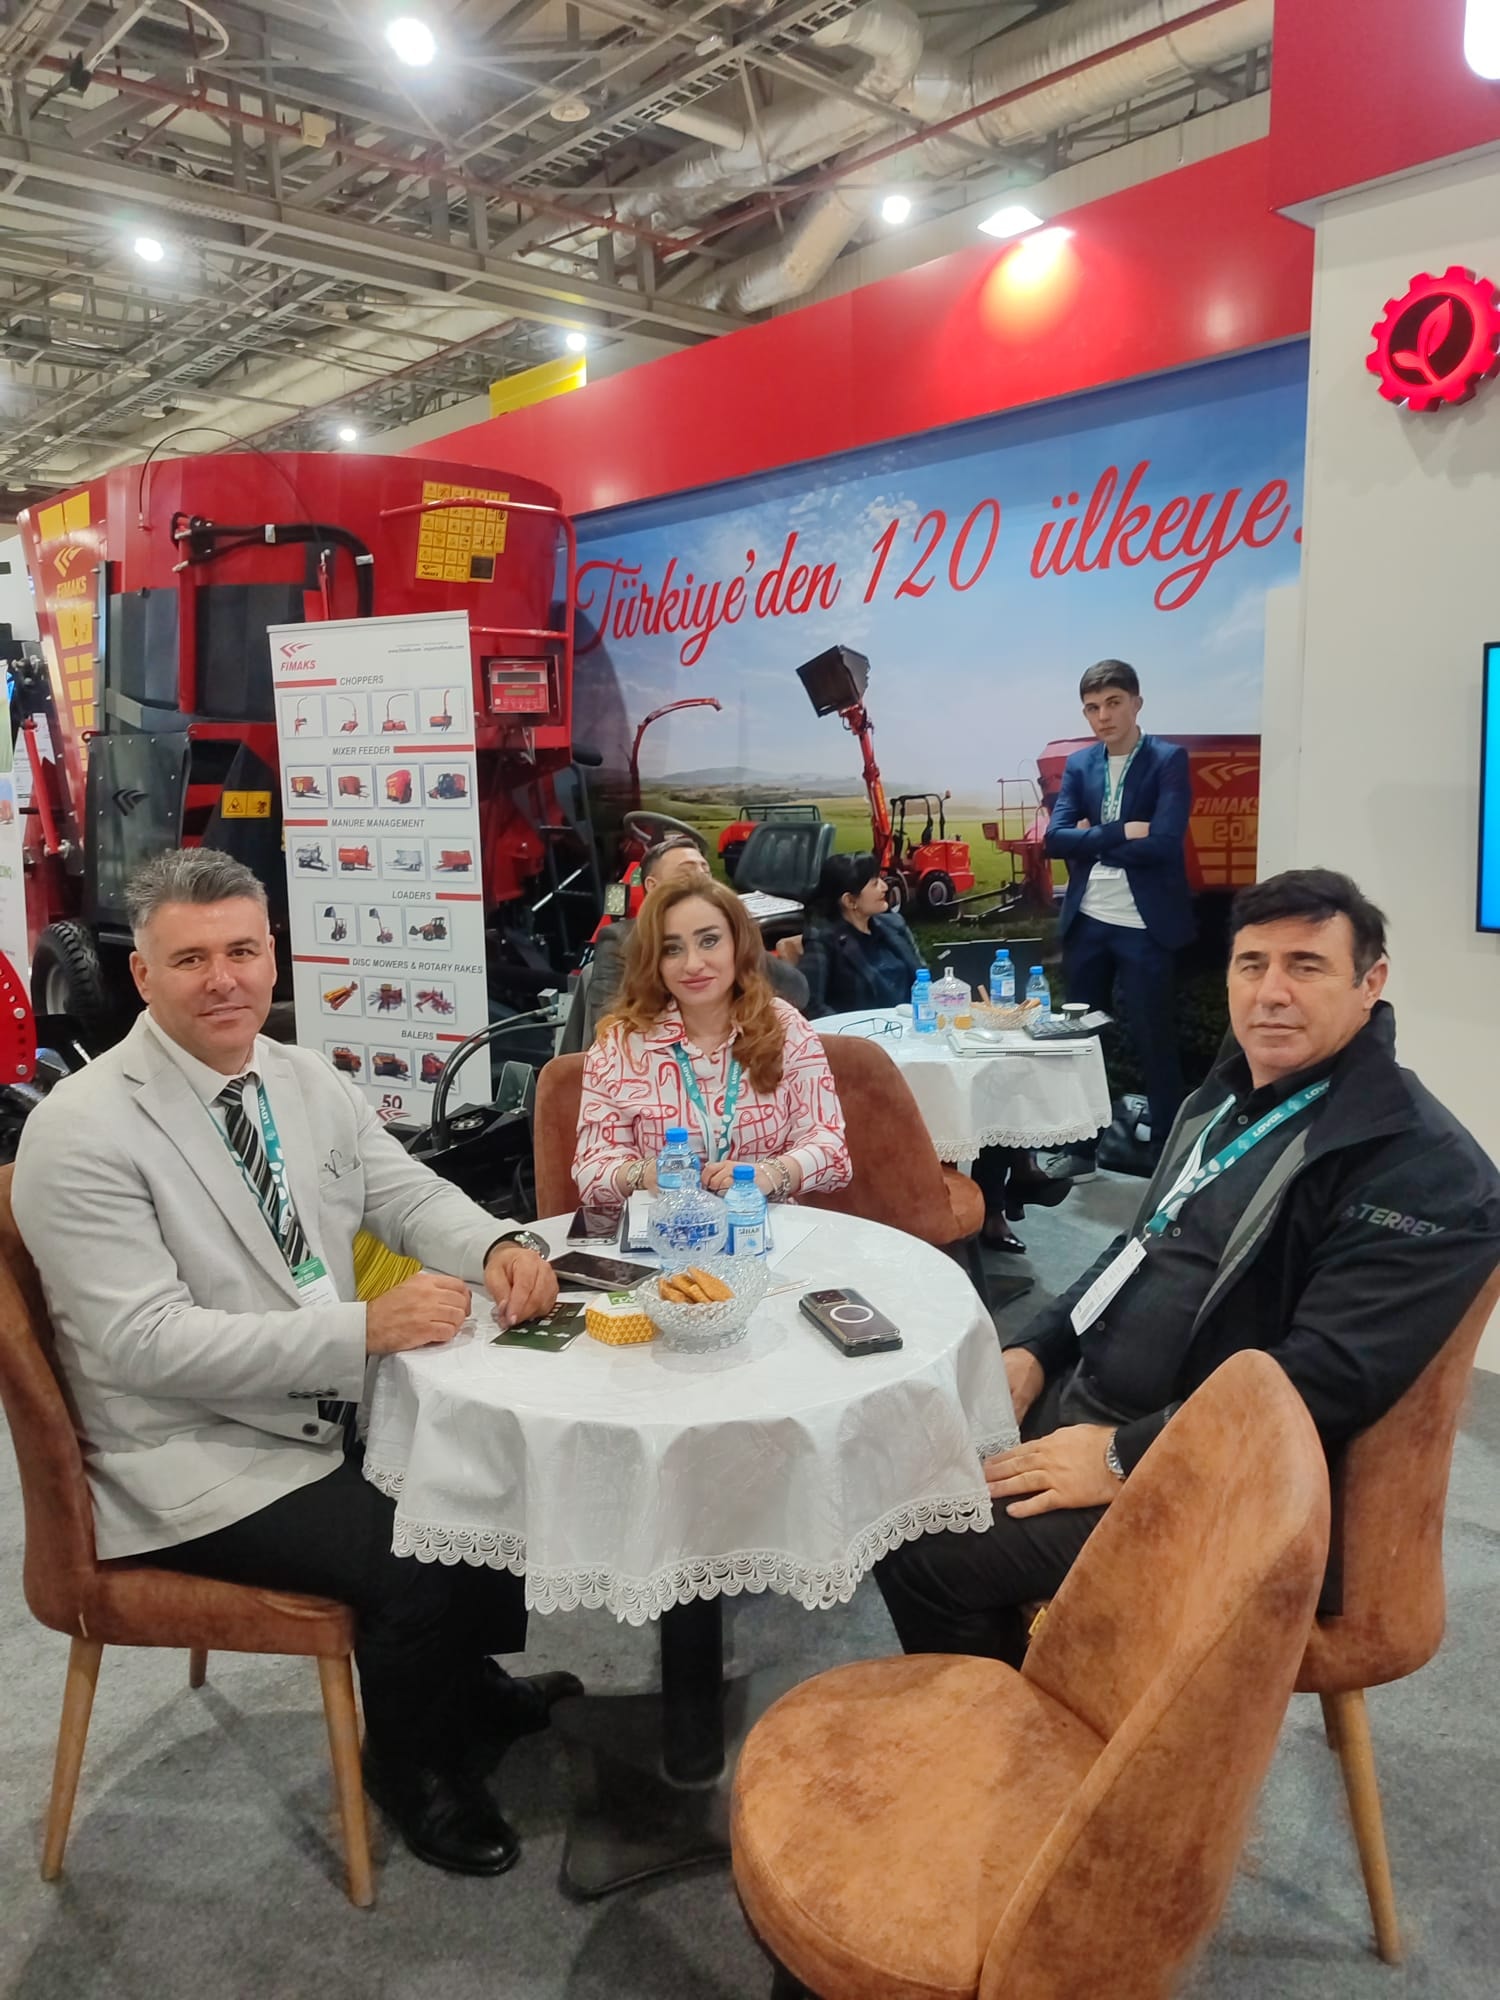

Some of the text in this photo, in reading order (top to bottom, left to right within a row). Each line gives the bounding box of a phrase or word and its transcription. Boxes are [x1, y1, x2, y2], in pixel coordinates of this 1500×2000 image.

[863, 498, 1001, 603] 120
[280, 660, 316, 672] FIMAKS
[339, 675, 384, 686] CHOPPERS
[332, 746, 390, 756] MIXER FEEDER
[331, 819, 425, 828] MANURE MANAGEMENT
[1214, 821, 1244, 842] 20
[392, 891, 432, 900] LOADERS
[352, 958, 483, 974] DISC MOWERS & ROTARY RAKES
[401, 1030, 434, 1041] BALERS
[382, 1094, 403, 1109] 50
[1252, 1112, 1284, 1138] LOVOL
